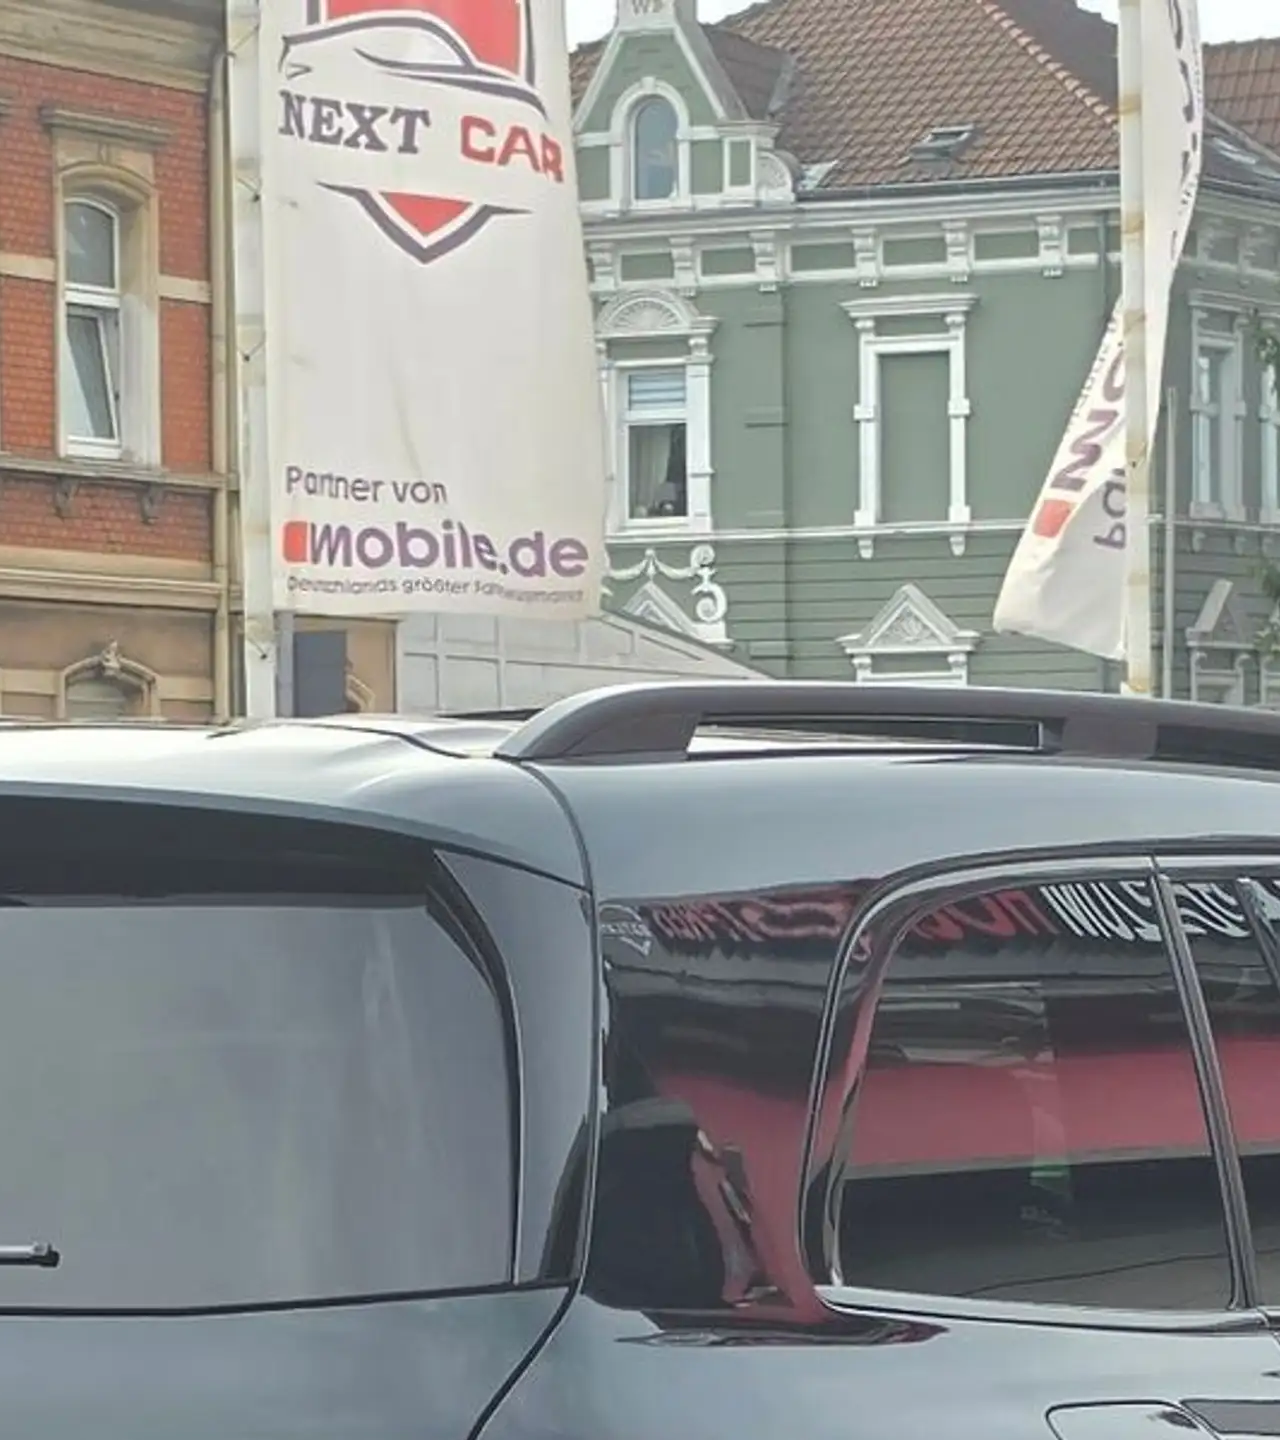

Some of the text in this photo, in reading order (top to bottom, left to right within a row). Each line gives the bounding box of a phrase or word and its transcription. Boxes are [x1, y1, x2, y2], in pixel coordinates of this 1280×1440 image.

[278, 90, 564, 182] NEXT CAR
[286, 465, 447, 504] Partner von
[310, 518, 589, 578] mobile.de
